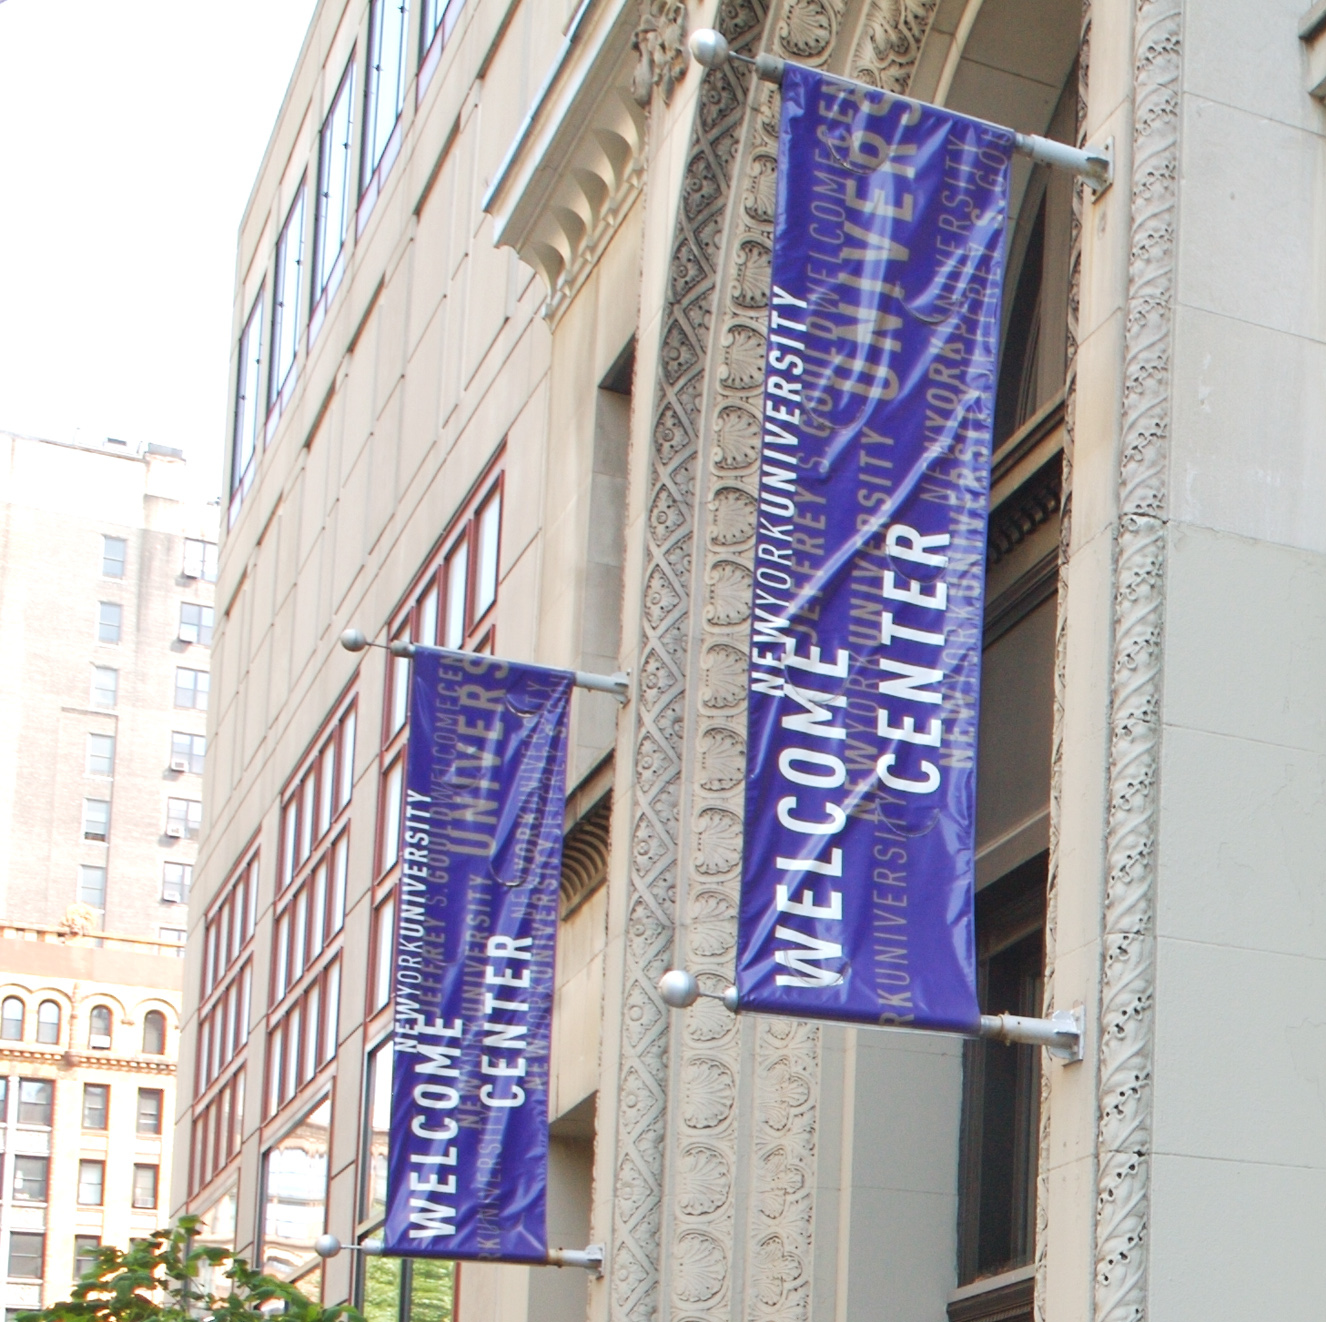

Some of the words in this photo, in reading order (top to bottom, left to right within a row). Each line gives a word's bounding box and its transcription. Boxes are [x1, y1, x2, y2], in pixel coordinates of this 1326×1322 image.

[876, 523, 950, 794] CENTER
[775, 637, 850, 988] WELCOME
[409, 1013, 463, 1239] WELCOME
[479, 934, 534, 1108] CENTER
